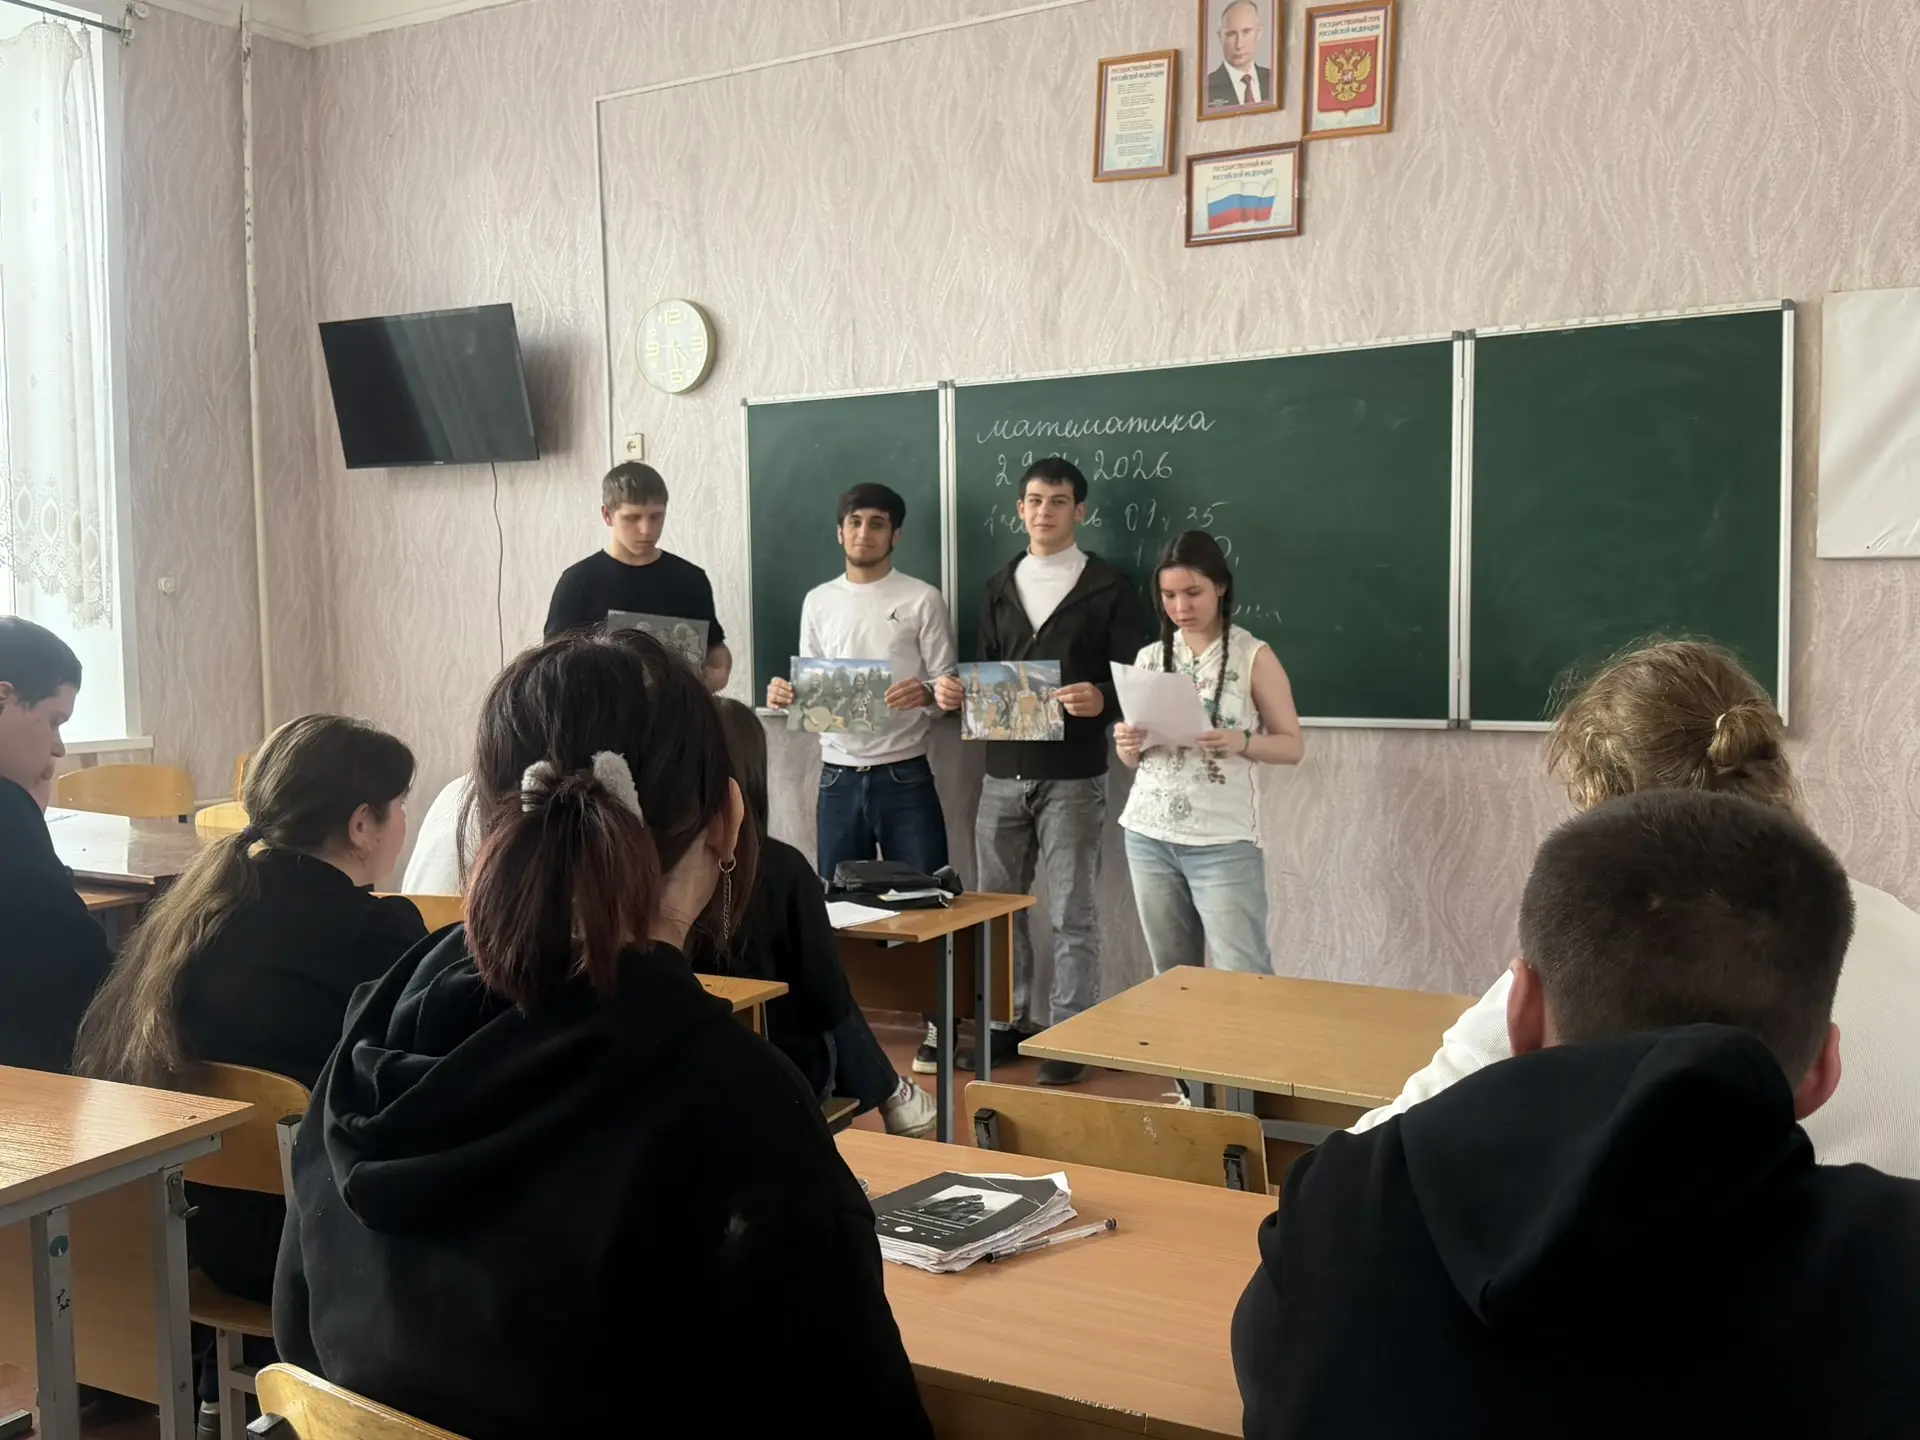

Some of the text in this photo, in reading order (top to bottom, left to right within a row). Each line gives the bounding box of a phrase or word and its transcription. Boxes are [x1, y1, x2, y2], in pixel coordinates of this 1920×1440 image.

[664, 308, 682, 326] 12
[645, 341, 660, 357] 9
[691, 336, 705, 352] 3
[1093, 449, 1173, 482] 2026
